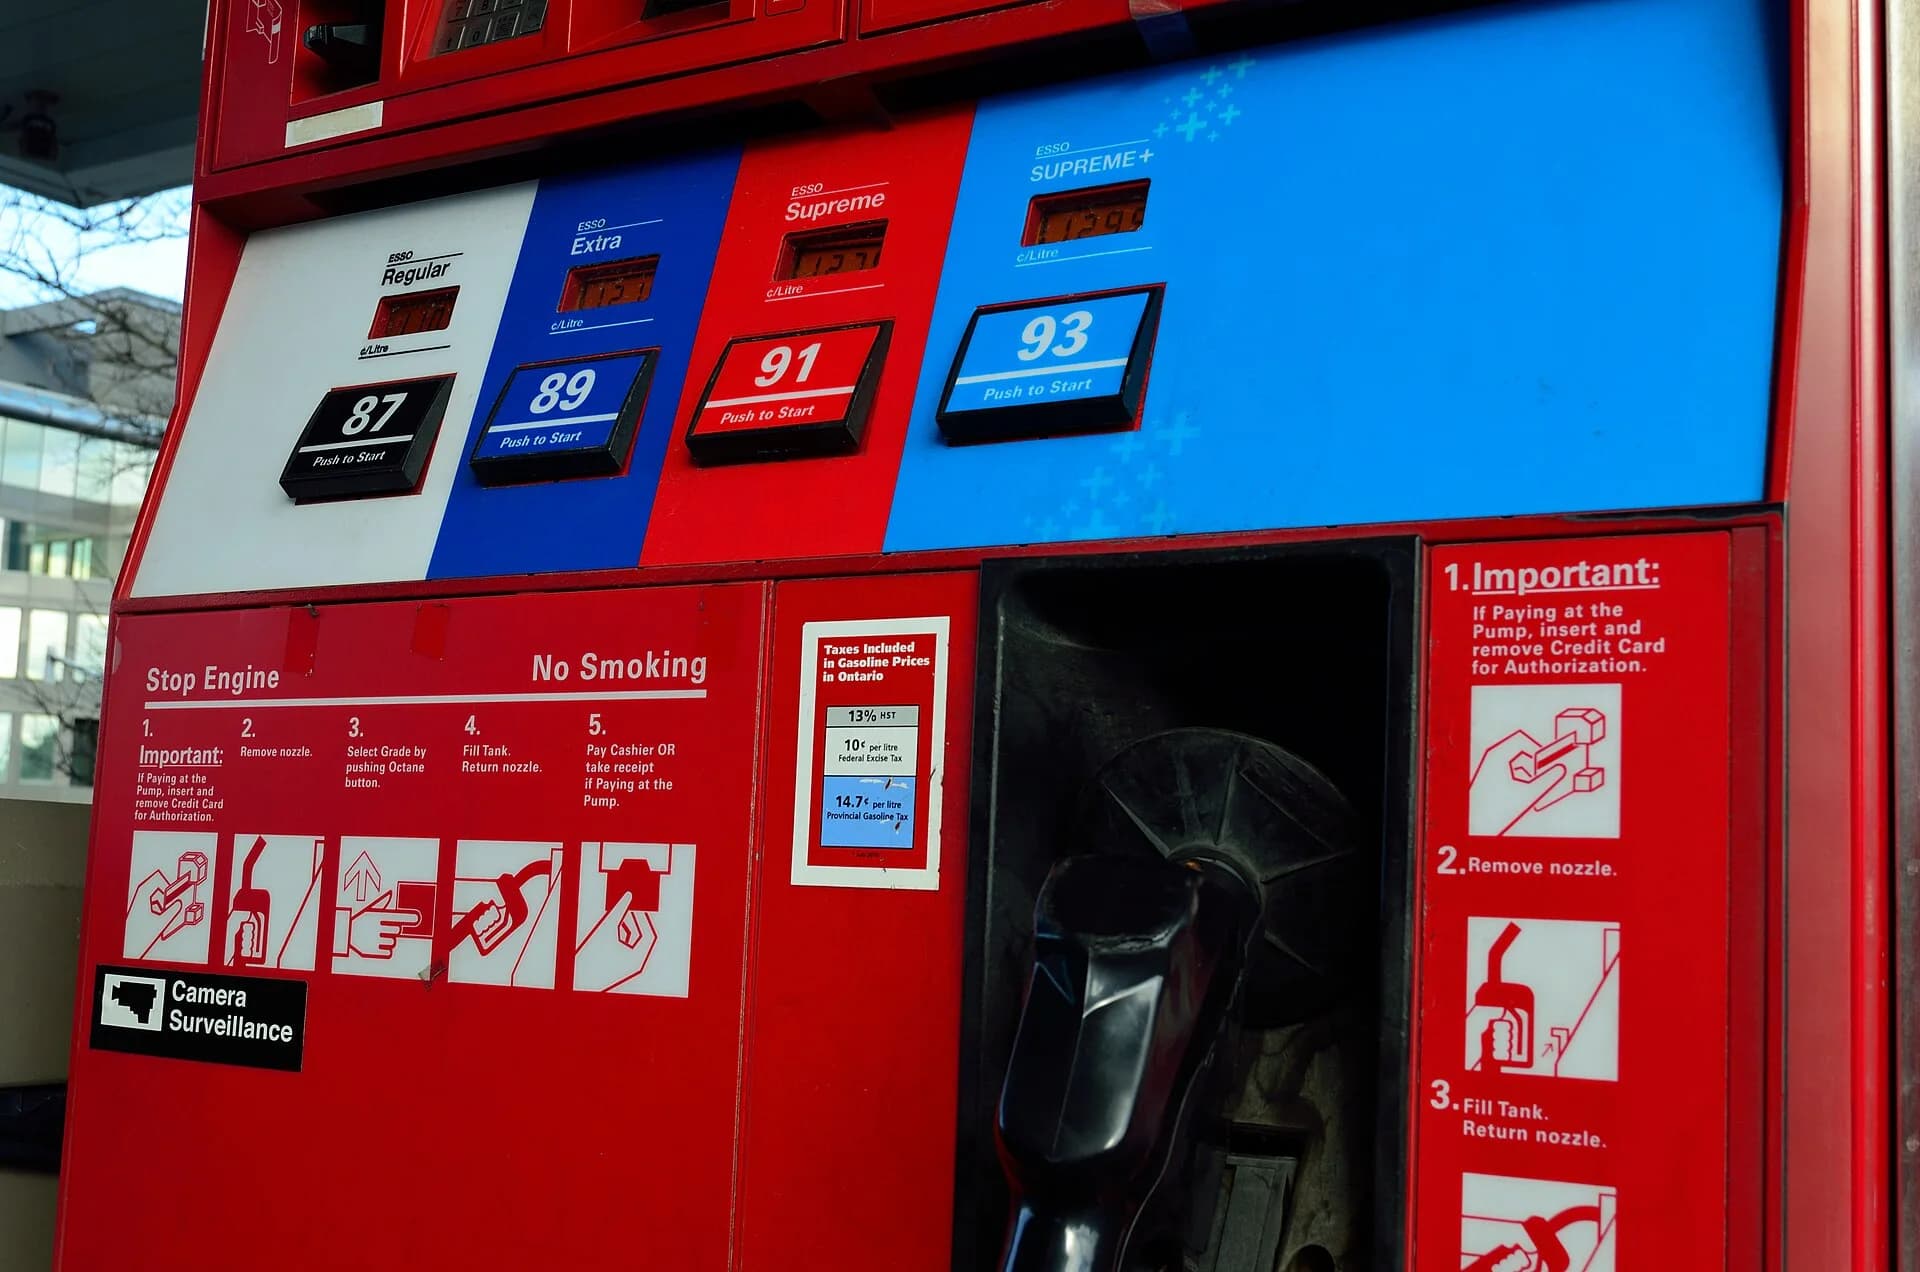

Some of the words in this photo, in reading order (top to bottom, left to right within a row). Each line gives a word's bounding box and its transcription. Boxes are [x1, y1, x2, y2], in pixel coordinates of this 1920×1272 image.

[1035, 142, 1070, 156] ESSO
[1030, 148, 1154, 182] SUPREME+
[791, 183, 823, 197] ESSO
[785, 193, 885, 221] Supreme
[577, 218, 606, 232] ESSO
[570, 235, 622, 255] Extra
[388, 251, 414, 263] ESSO
[381, 262, 451, 286] Regular
[1017, 310, 1093, 361] 93
[754, 342, 822, 387] 91
[529, 369, 596, 414] 89
[983, 386, 1023, 400] Push
[1028, 385, 1045, 397] to
[1050, 378, 1092, 393] Start
[341, 392, 409, 436] 87
[720, 410, 755, 425] Push
[758, 410, 774, 421] to
[778, 405, 815, 419] Start
[499, 435, 531, 449] Push
[533, 436, 547, 446] to
[549, 431, 582, 444] Start
[312, 454, 341, 467] Push
[342, 453, 354, 464] to
[356, 451, 386, 463] Start
[1444, 563, 1469, 591] 1.
[1472, 558, 1661, 596] Important:
[1473, 606, 1486, 621] If
[1492, 605, 1557, 623] Paying
[1564, 604, 1583, 619] at
[1590, 602, 1624, 617] the
[1473, 624, 1534, 641] Pump,
[1540, 622, 1597, 637] insert
[1604, 619, 1642, 635] and
[824, 644, 860, 655] Taxes
[863, 641, 916, 654] Included
[1472, 643, 1544, 657] remove
[1550, 639, 1611, 655] Credit
[1618, 638, 1665, 654] Card
[532, 654, 570, 681] No
[580, 650, 707, 684] Smoking
[823, 657, 835, 669] in
[838, 657, 889, 668] Gasoline
[892, 656, 930, 667] Prices
[1471, 660, 1498, 675] for
[1504, 657, 1647, 675] Authorization.
[146, 667, 196, 696] Stop
[203, 665, 280, 695] Engine
[822, 671, 834, 682] in
[838, 670, 884, 682] Ontario
[588, 713, 606, 736] 5.
[848, 709, 877, 722] 13%
[880, 711, 896, 720] HST
[142, 718, 153, 737] 1.
[241, 717, 256, 738] 2.
[348, 716, 364, 738] 3.
[464, 715, 481, 736] 4.
[139, 744, 224, 769] Important:
[240, 746, 278, 758] Remove
[279, 747, 313, 758] nozzle.
[347, 745, 378, 757] Select
[381, 745, 411, 757] Grade
[414, 745, 427, 760] by
[463, 744, 480, 757] Fill
[482, 744, 511, 757] Tank.
[587, 744, 607, 759] Pay
[610, 743, 654, 756] Cashier
[657, 743, 676, 756] OR
[869, 745, 882, 753] per
[883, 743, 898, 751] litre
[462, 760, 499, 773] Return
[502, 760, 543, 773] nozzle.
[838, 754, 864, 762] Federal
[866, 754, 888, 762] Excise
[890, 754, 903, 762] Tax
[345, 761, 386, 775] pushing
[389, 761, 425, 773] Octane
[585, 761, 610, 773] take
[614, 761, 654, 776] receipt
[137, 772, 144, 783] If
[146, 773, 177, 786] Paying
[179, 774, 189, 783] at
[191, 773, 207, 783] the
[345, 776, 381, 788] button.
[584, 777, 593, 790] if
[596, 777, 635, 793] Paying
[638, 779, 650, 790] at
[654, 778, 673, 790] the
[136, 785, 165, 798] Pump,
[167, 785, 194, 796] insert
[196, 785, 215, 796] and
[135, 799, 169, 808] remove
[171, 798, 199, 809] Credit
[202, 798, 224, 809] Card
[583, 794, 620, 810] Pump.
[872, 802, 885, 810] per
[886, 800, 902, 809] litre
[134, 809, 147, 820] for
[149, 810, 215, 822] Authorization.
[827, 811, 861, 820] Provincial
[863, 812, 894, 821] Gasoline
[896, 813, 909, 821] Tax
[1436, 845, 1466, 875] 2.
[1468, 856, 1544, 874] Remove
[1549, 860, 1618, 877] nozzle.
[172, 979, 247, 1008] Camera
[169, 1008, 293, 1043] Surveillance
[1430, 1079, 1460, 1110] 3.
[1463, 1098, 1492, 1116] Fill
[1497, 1100, 1549, 1121] Tank.
[1463, 1120, 1528, 1141] Return
[1536, 1128, 1607, 1149] nozzle.
